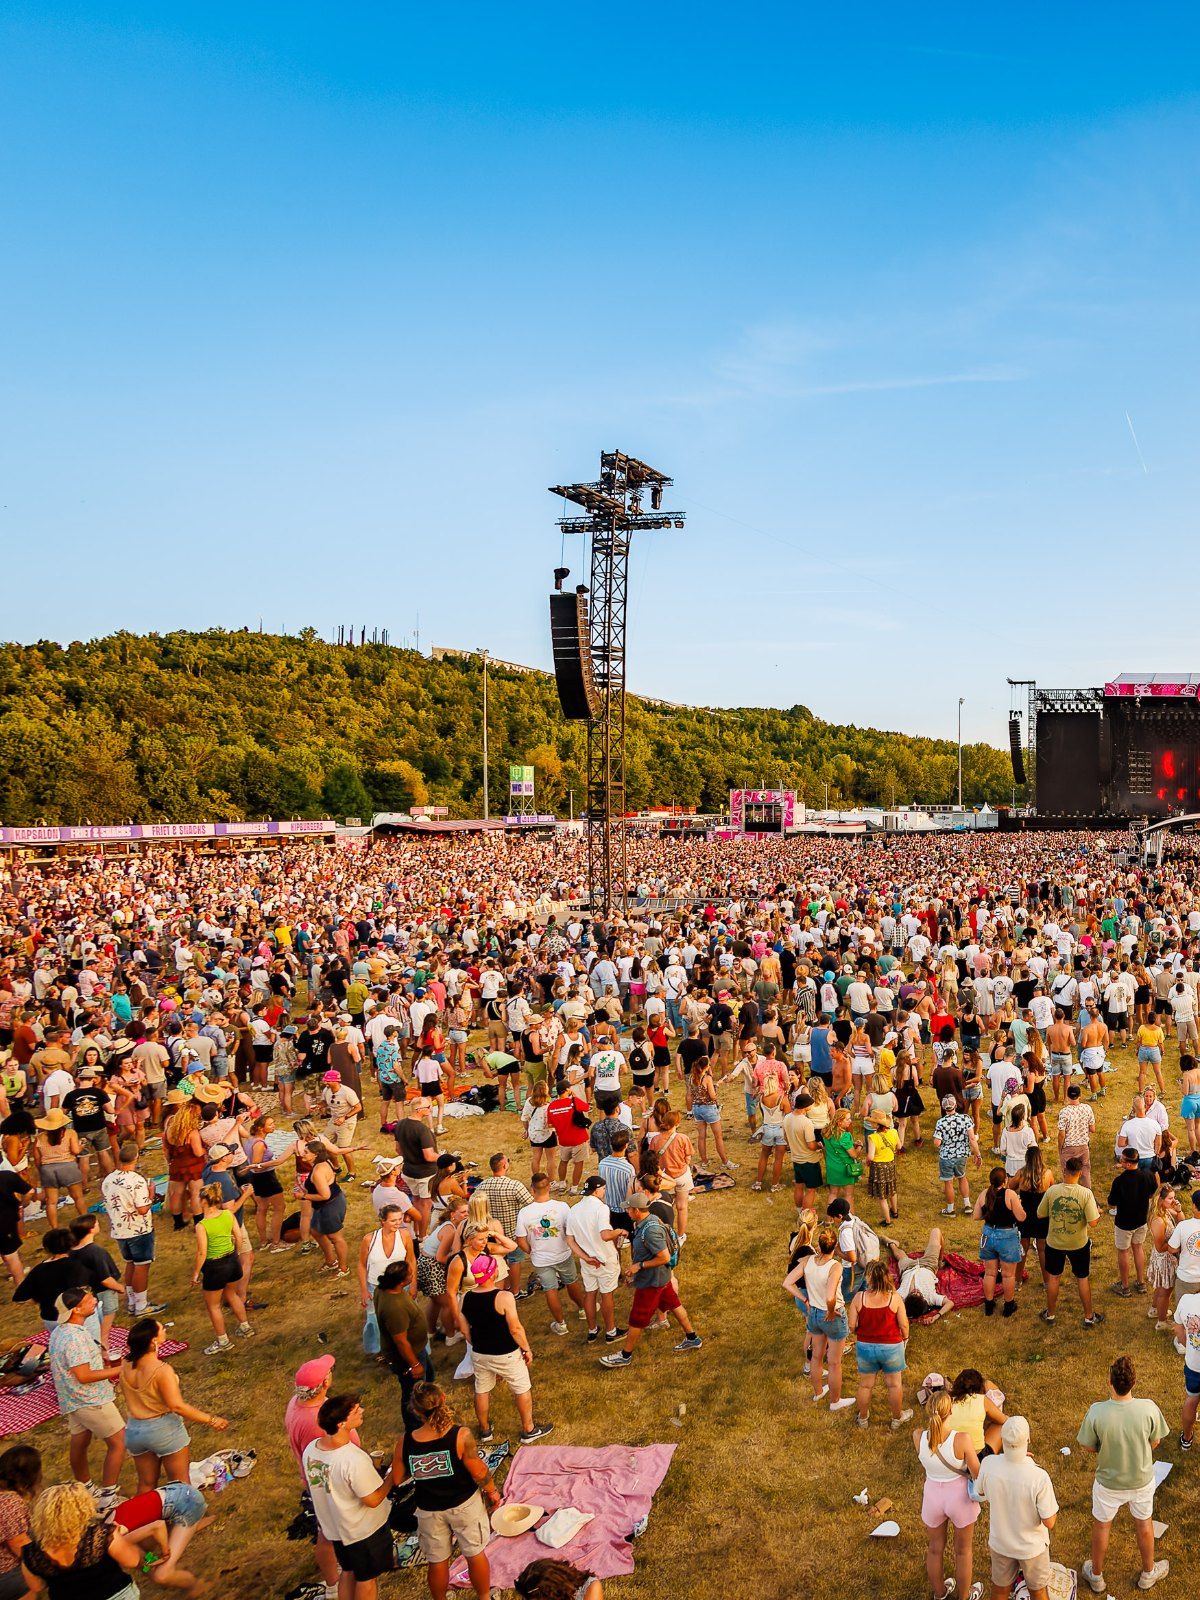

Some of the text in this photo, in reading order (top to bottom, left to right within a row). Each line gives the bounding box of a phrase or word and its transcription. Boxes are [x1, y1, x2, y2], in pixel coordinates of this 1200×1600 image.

[512, 784, 522, 792] WC
[15, 829, 58, 840] KAPSALON
[152, 826, 170, 835] FRIET
[179, 825, 206, 835] SNACKS
